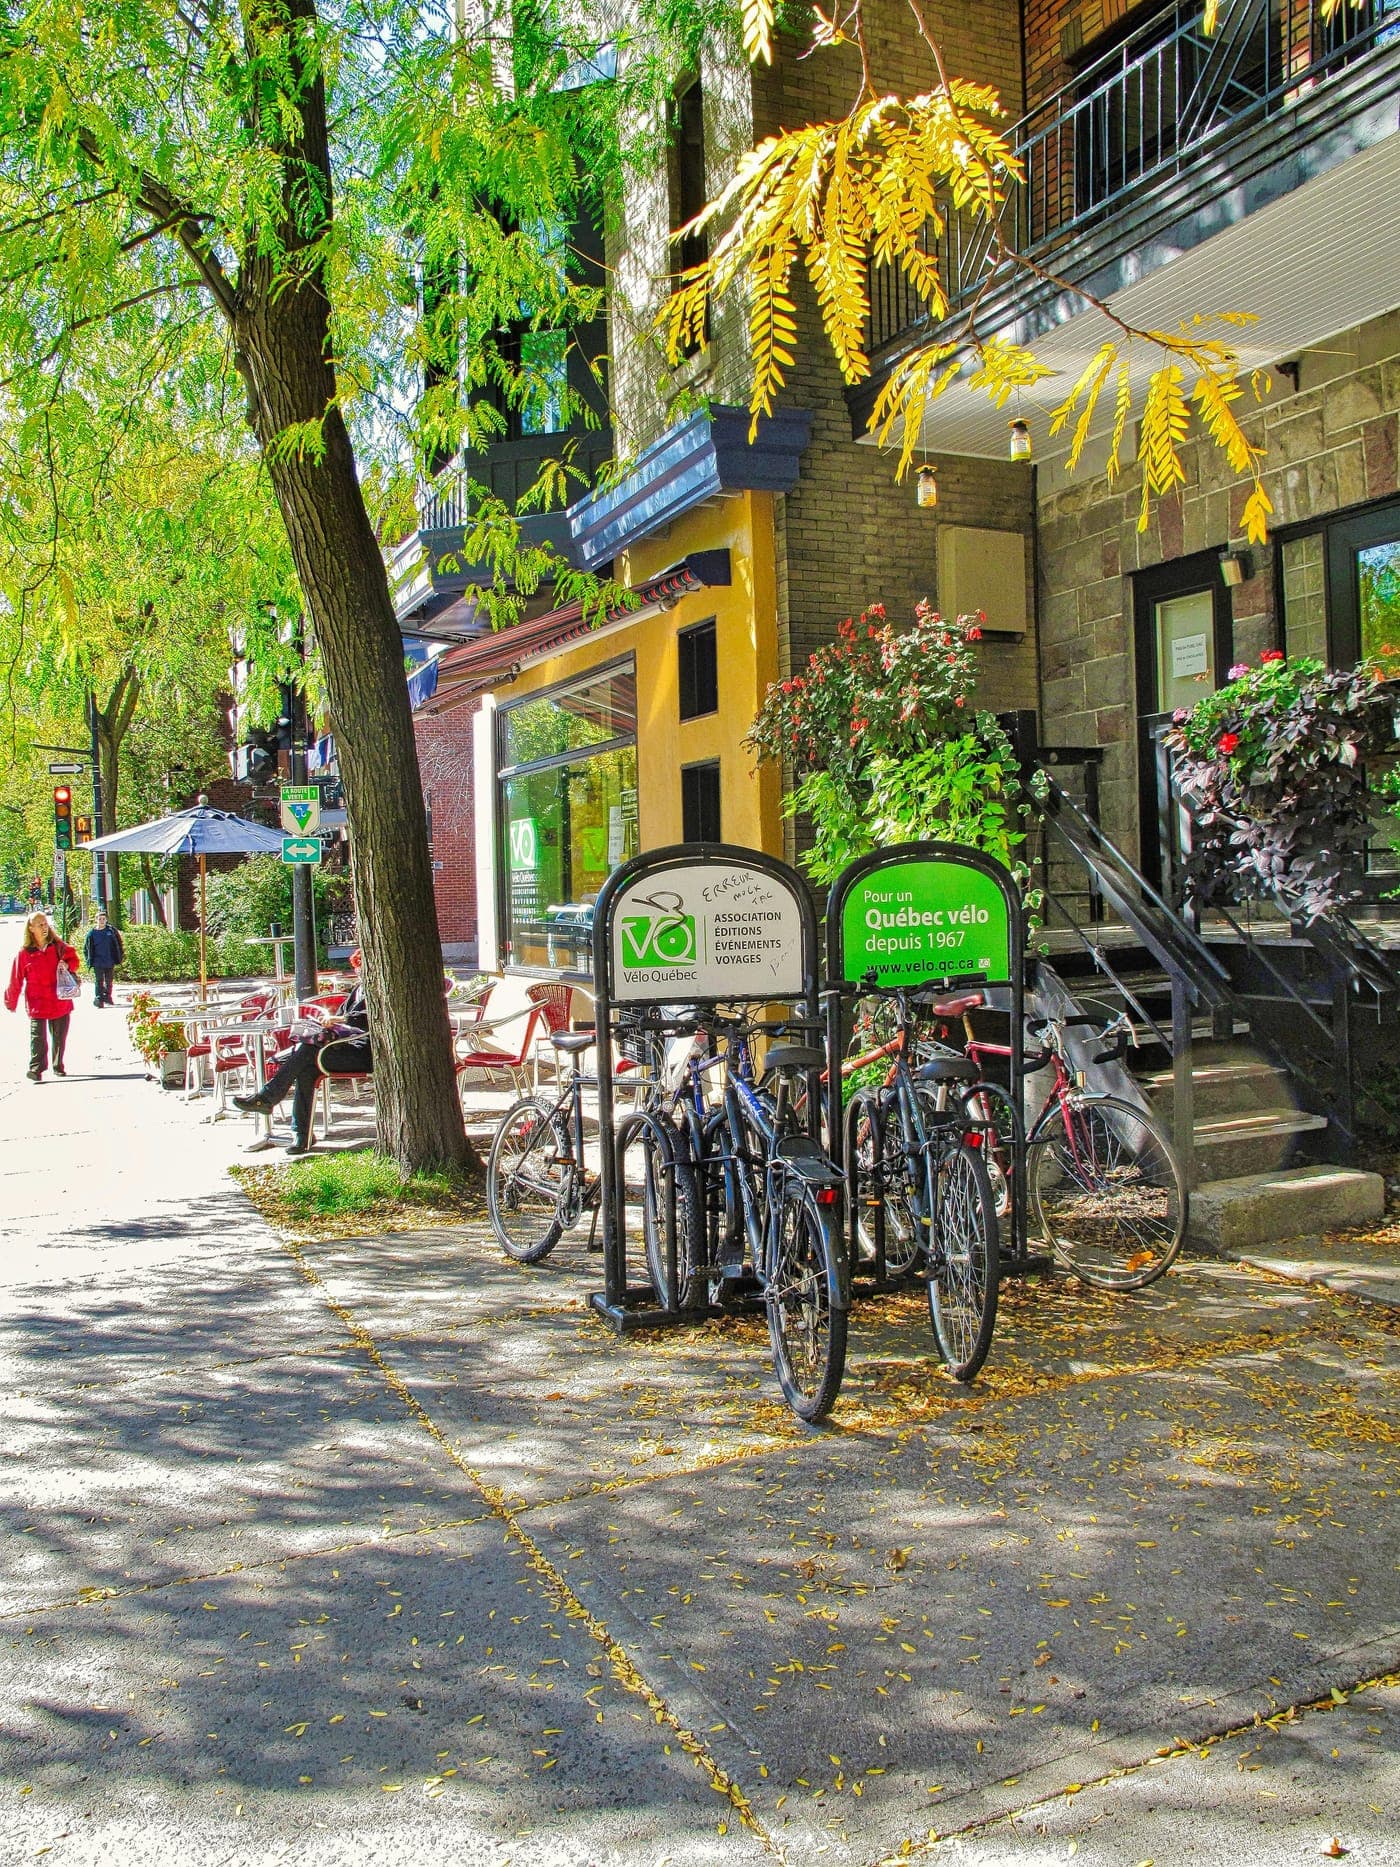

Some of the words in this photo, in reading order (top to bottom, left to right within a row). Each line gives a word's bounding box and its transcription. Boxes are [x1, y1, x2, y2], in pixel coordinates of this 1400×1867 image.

[702, 872, 754, 902] ERREUR
[864, 890, 893, 903] Pour
[896, 891, 913, 902] un
[714, 911, 782, 923] ASSOCIATION
[865, 906, 944, 931] Québec
[947, 904, 989, 925] vélo
[714, 925, 762, 937] ÉDITIONS
[715, 939, 782, 951] ÉVÉNEMENTS
[865, 933, 922, 955] depuis
[927, 931, 965, 949] 1967
[715, 953, 762, 965] VOYAGES
[866, 959, 974, 974] www.velo.qc.ca
[623, 971, 650, 983] Vélo
[651, 969, 698, 983] Québec
